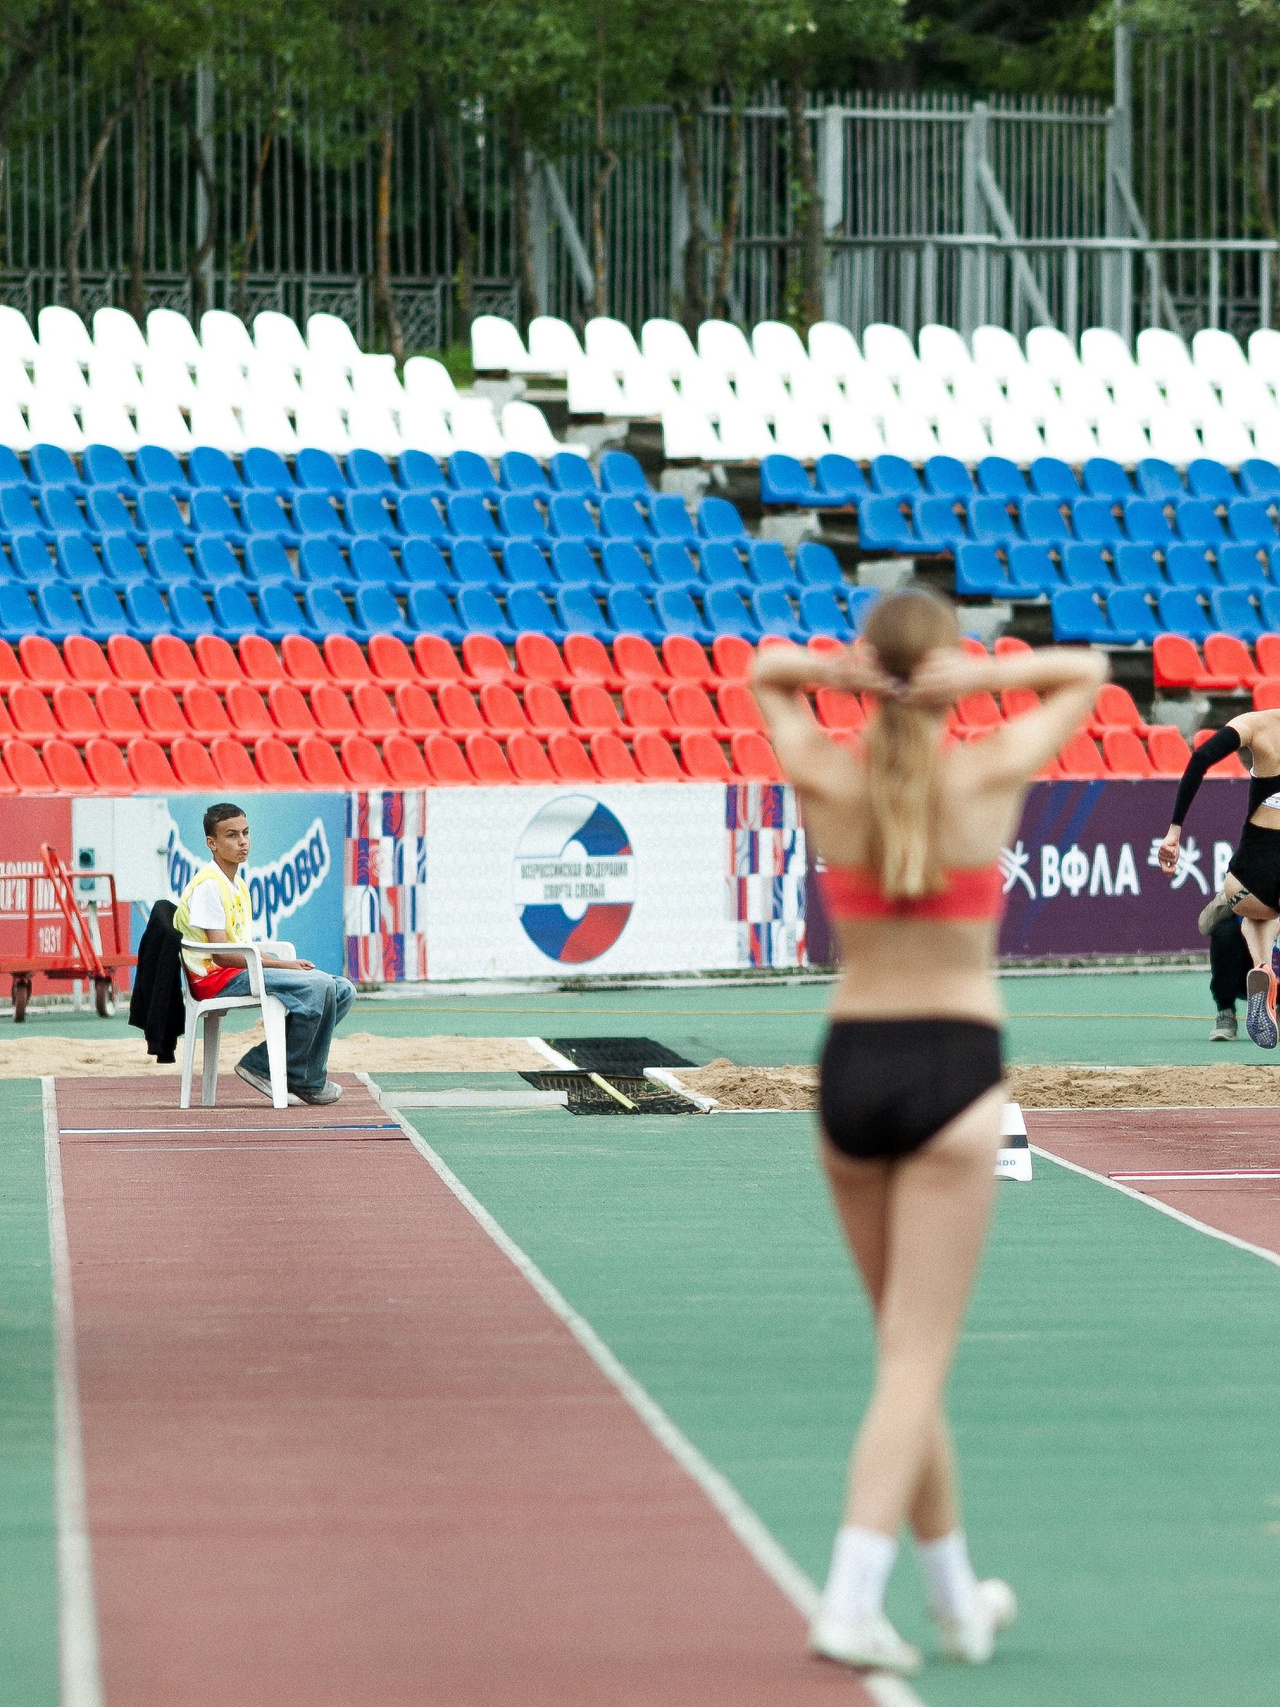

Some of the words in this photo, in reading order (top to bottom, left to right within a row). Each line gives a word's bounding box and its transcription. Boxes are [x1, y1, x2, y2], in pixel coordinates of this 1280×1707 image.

[240, 828, 326, 940] орова
[1041, 842, 1141, 898] ВФЛА
[38, 925, 61, 953] 1931
